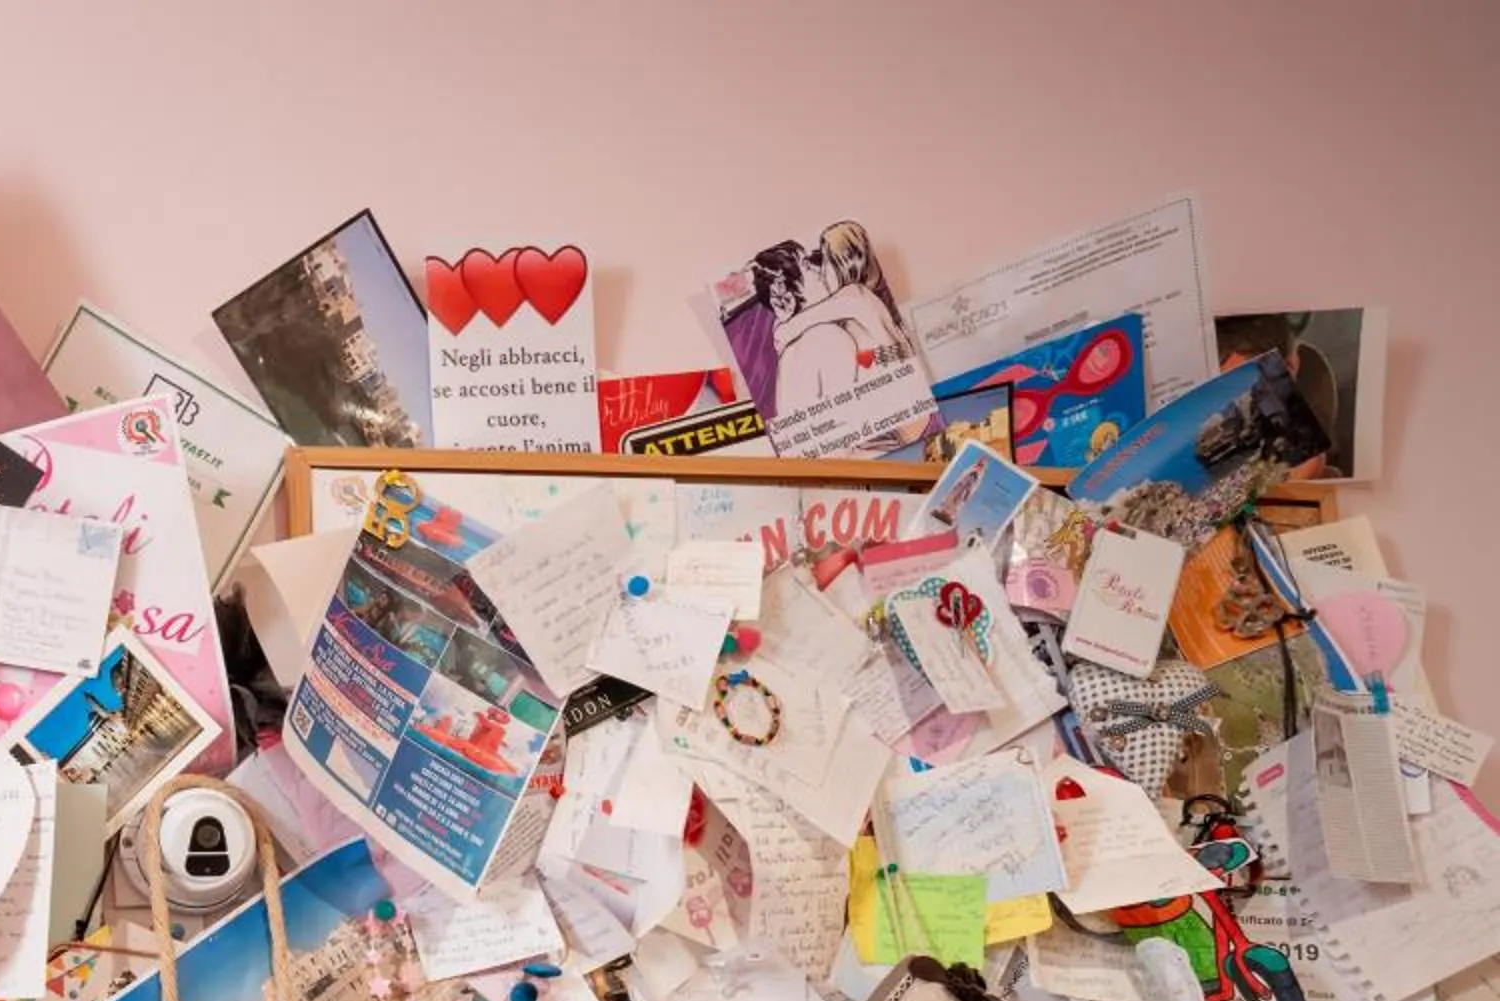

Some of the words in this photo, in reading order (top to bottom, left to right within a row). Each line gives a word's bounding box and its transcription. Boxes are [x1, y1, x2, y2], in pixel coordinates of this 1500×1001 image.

[442, 348, 491, 371] Negli
[499, 345, 585, 366] abbracci,
[433, 386, 454, 398] se
[459, 380, 525, 397] accosti
[531, 377, 579, 395] bene
[584, 374, 596, 393] il
[854, 373, 889, 404] persona
[894, 364, 915, 380] con
[486, 413, 546, 431] cuore,
[643, 416, 765, 456] ATTENZI
